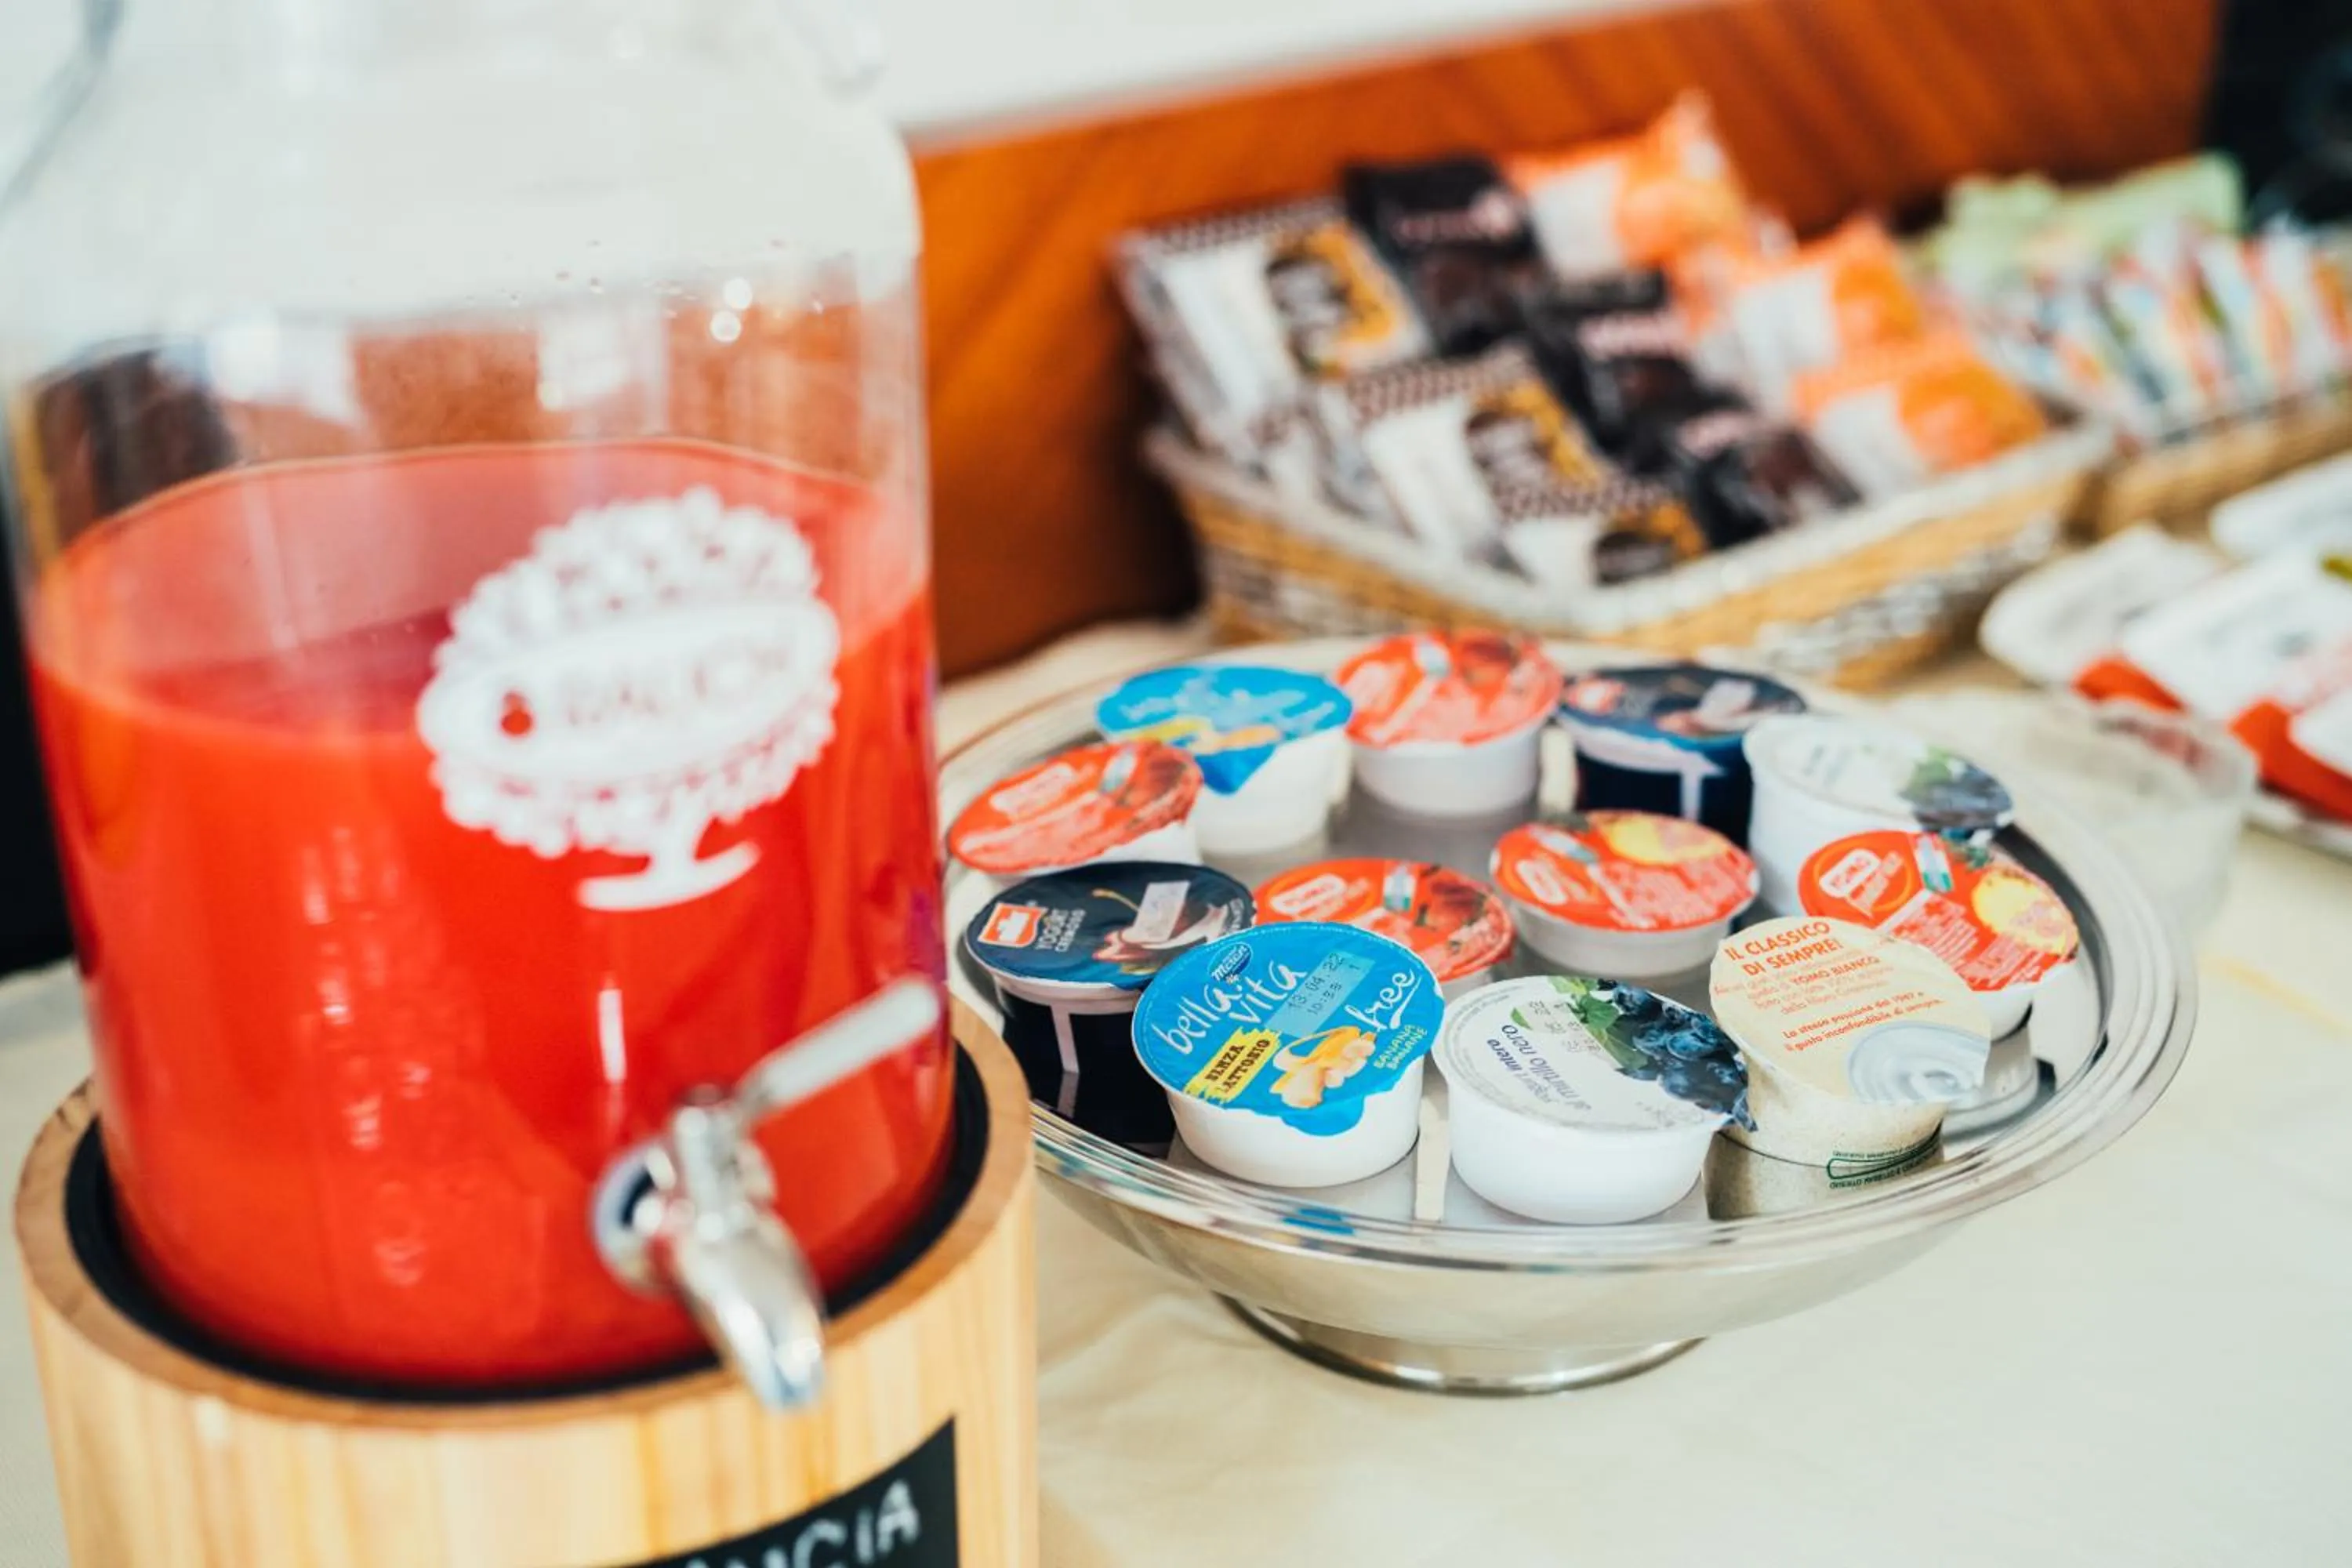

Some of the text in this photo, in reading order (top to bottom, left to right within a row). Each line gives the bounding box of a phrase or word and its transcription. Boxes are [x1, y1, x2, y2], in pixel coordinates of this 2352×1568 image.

[1724, 921, 1831, 961] IL CLASSICO
[1741, 960, 1767, 977] DI
[1229, 960, 1308, 1023] vita
[1151, 984, 1243, 1054] bella
[1501, 1024, 1537, 1055] nero
[1205, 1044, 1246, 1082] SENZA
